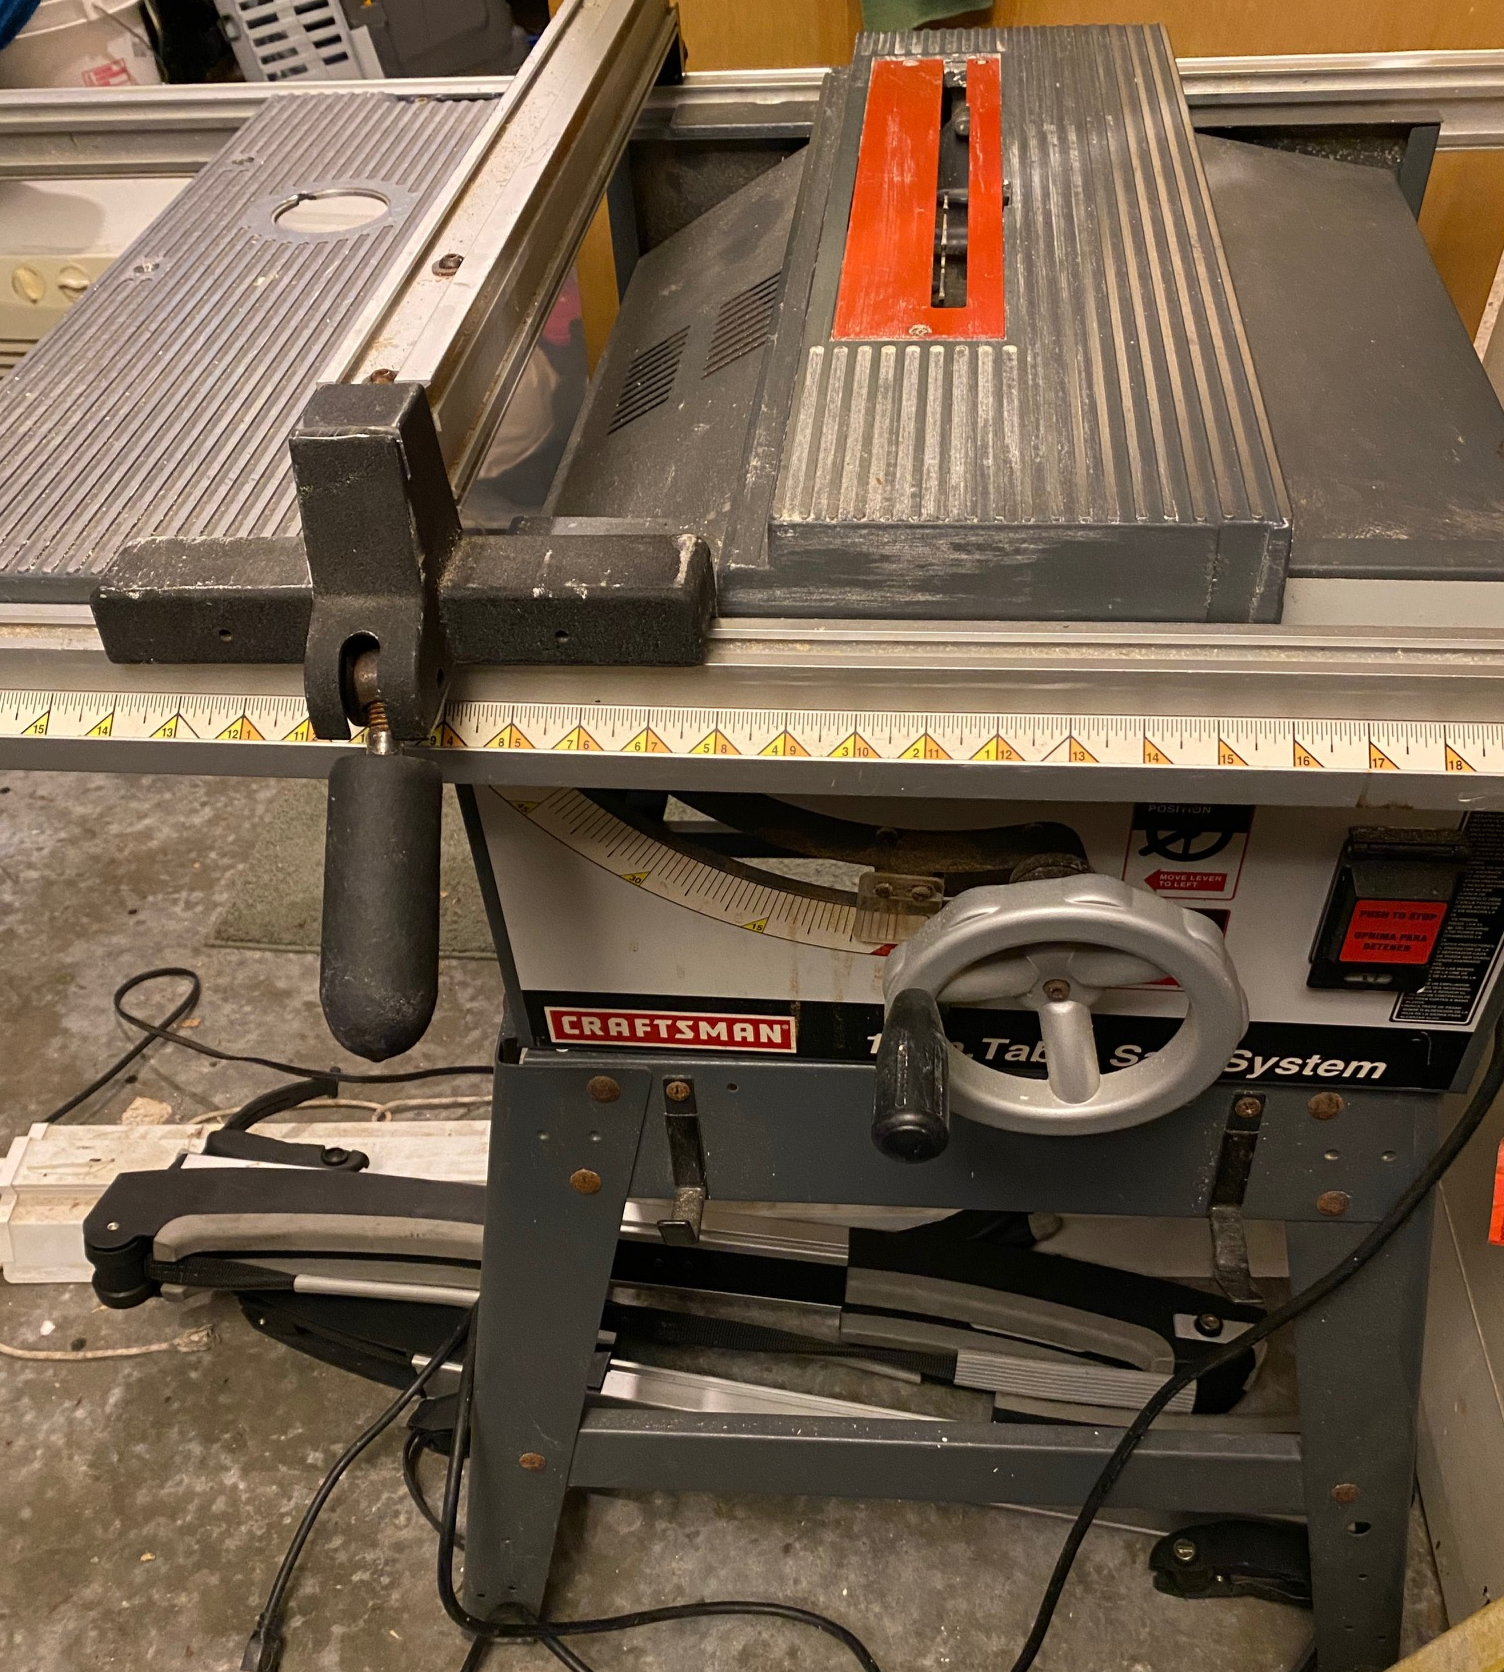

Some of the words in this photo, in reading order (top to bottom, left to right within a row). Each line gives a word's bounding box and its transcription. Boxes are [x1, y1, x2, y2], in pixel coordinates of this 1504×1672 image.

[33, 724, 45, 734] 15
[97, 726, 108, 736] 14
[162, 728, 173, 738] 13
[227, 729, 239, 739] 12
[246, 730, 251, 739] 1
[294, 731, 305, 741] 11
[430, 736, 437, 746] 9
[446, 736, 454, 746] 4
[498, 737, 505, 747] 8
[514, 738, 521, 748] 5
[567, 740, 574, 749] 7
[583, 740, 590, 750] 6
[634, 741, 641, 751] 6
[651, 742, 658, 752] 7
[703, 743, 710, 753] 5
[720, 744, 727, 754] 8
[771, 746, 779, 755] 4
[789, 746, 796, 755] 9
[842, 747, 849, 757] 3
[857, 747, 869, 757] 10
[913, 748, 920, 758] 2
[928, 748, 939, 758] 11
[984, 749, 990, 759] 1
[1000, 750, 1012, 760] 12
[1073, 751, 1085, 761] 13
[1146, 753, 1159, 763] 14
[1221, 754, 1234, 764] 15
[1297, 756, 1310, 766] 16
[1372, 758, 1385, 768] 17
[1449, 760, 1462, 771] 18
[628, 875, 642, 884] 30
[1359, 910, 1389, 918] PUSH
[1410, 912, 1437, 920] STOP
[751, 923, 762, 931] 15
[1354, 932, 1397, 940] OPRIMA
[1399, 934, 1427, 942] PARA
[1363, 943, 1411, 951] DETENER
[562, 1015, 781, 1043] CRAFTSMAN
[981, 1037, 1047, 1063] Tab
[1224, 1049, 1387, 1078] System
